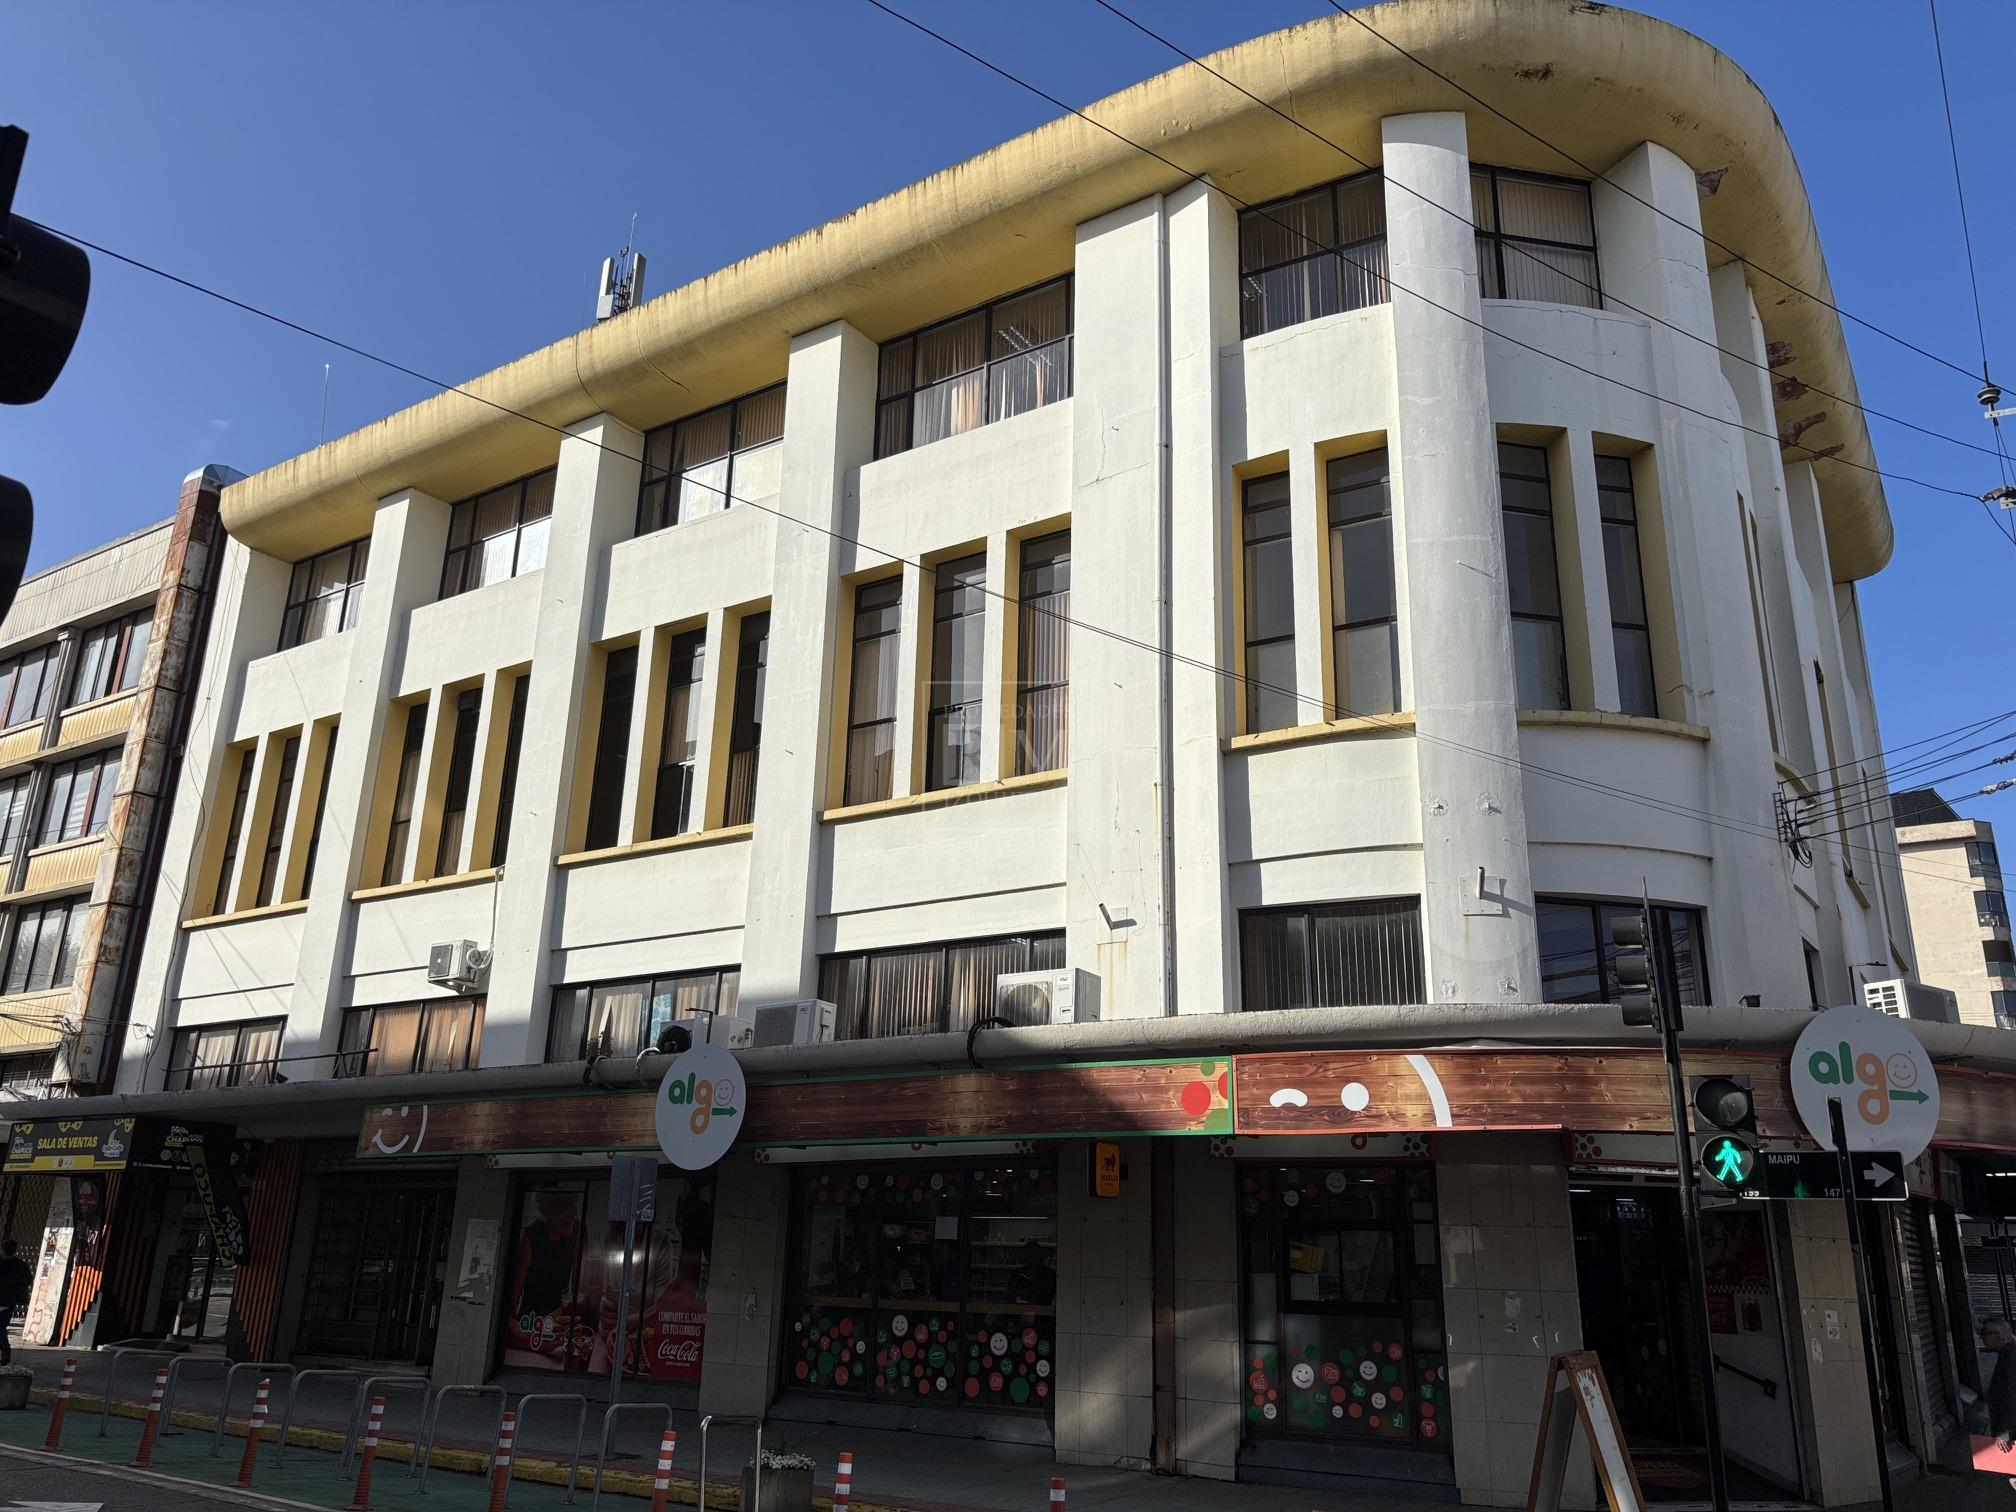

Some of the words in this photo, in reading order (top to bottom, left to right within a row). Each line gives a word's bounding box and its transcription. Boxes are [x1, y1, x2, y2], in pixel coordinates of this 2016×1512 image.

[36, 1137, 56, 1150] SALA
[57, 1137, 68, 1149] DE
[68, 1136, 99, 1149] VENTAS
[1768, 1154, 1800, 1165] MAIPU
